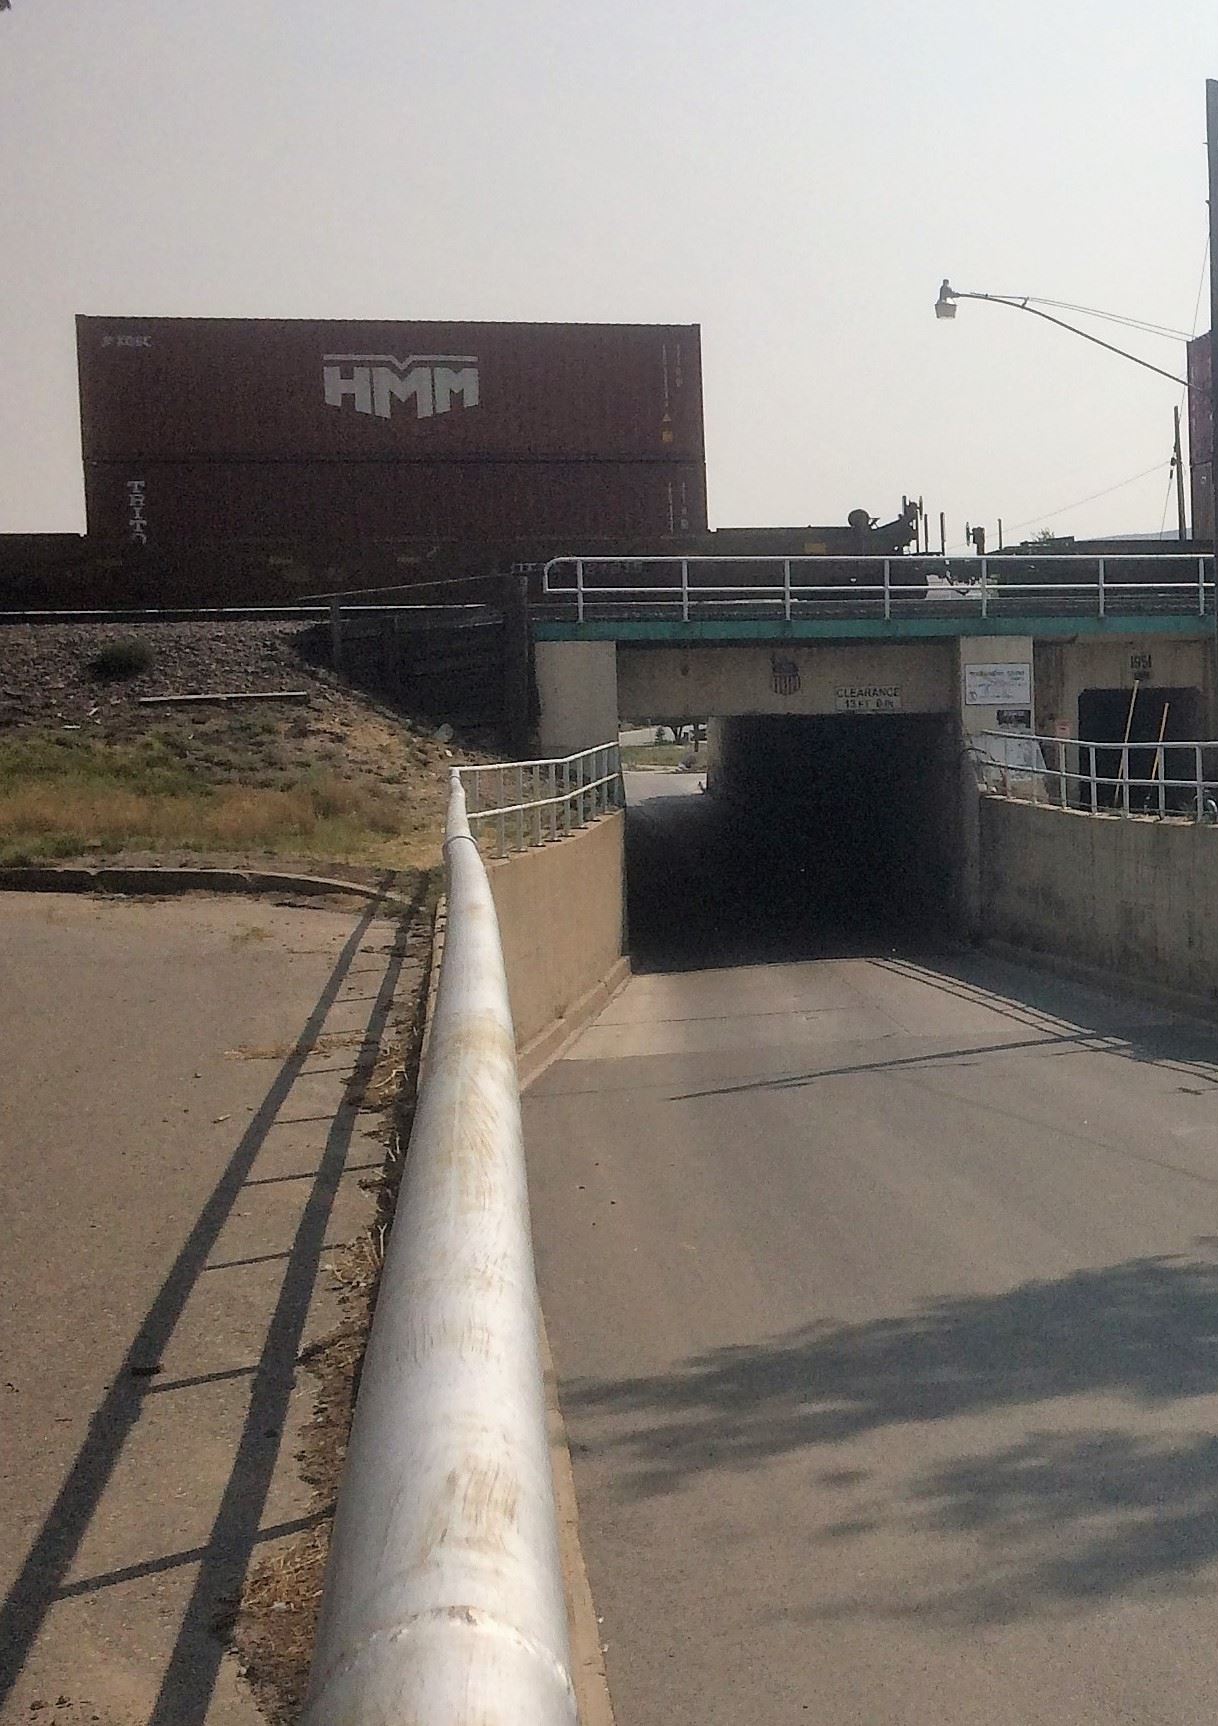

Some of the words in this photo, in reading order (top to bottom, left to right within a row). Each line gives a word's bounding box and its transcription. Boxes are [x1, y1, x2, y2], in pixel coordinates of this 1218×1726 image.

[323, 361, 480, 419] HMM
[1130, 654, 1153, 669] 1951
[835, 686, 901, 699] CLEARANCE
